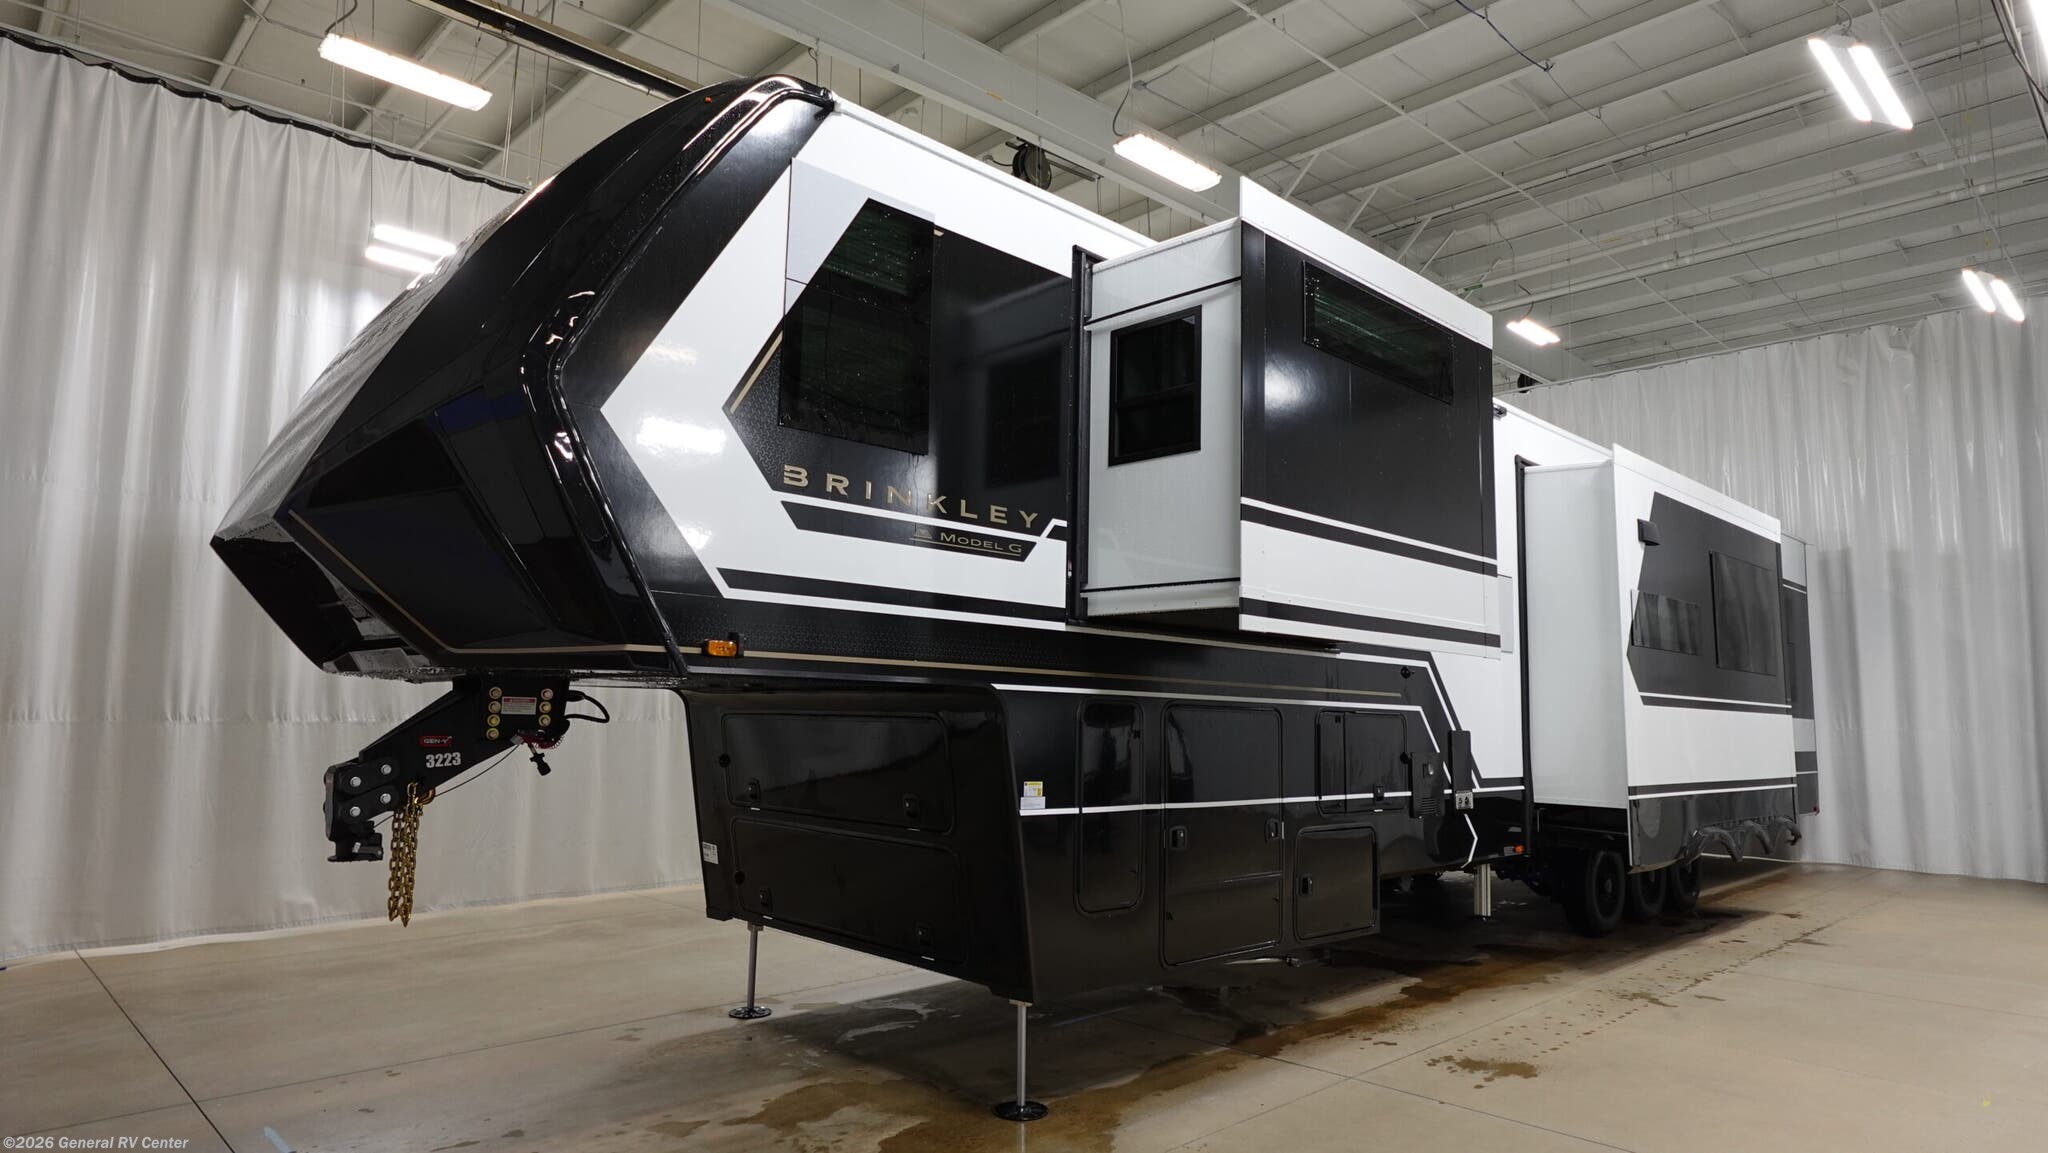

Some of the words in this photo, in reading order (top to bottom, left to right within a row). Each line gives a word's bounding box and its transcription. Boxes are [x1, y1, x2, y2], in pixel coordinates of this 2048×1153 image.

[783, 464, 1039, 528] BRINKLEY
[1008, 543, 1022, 554] G
[425, 751, 462, 769] 3223
